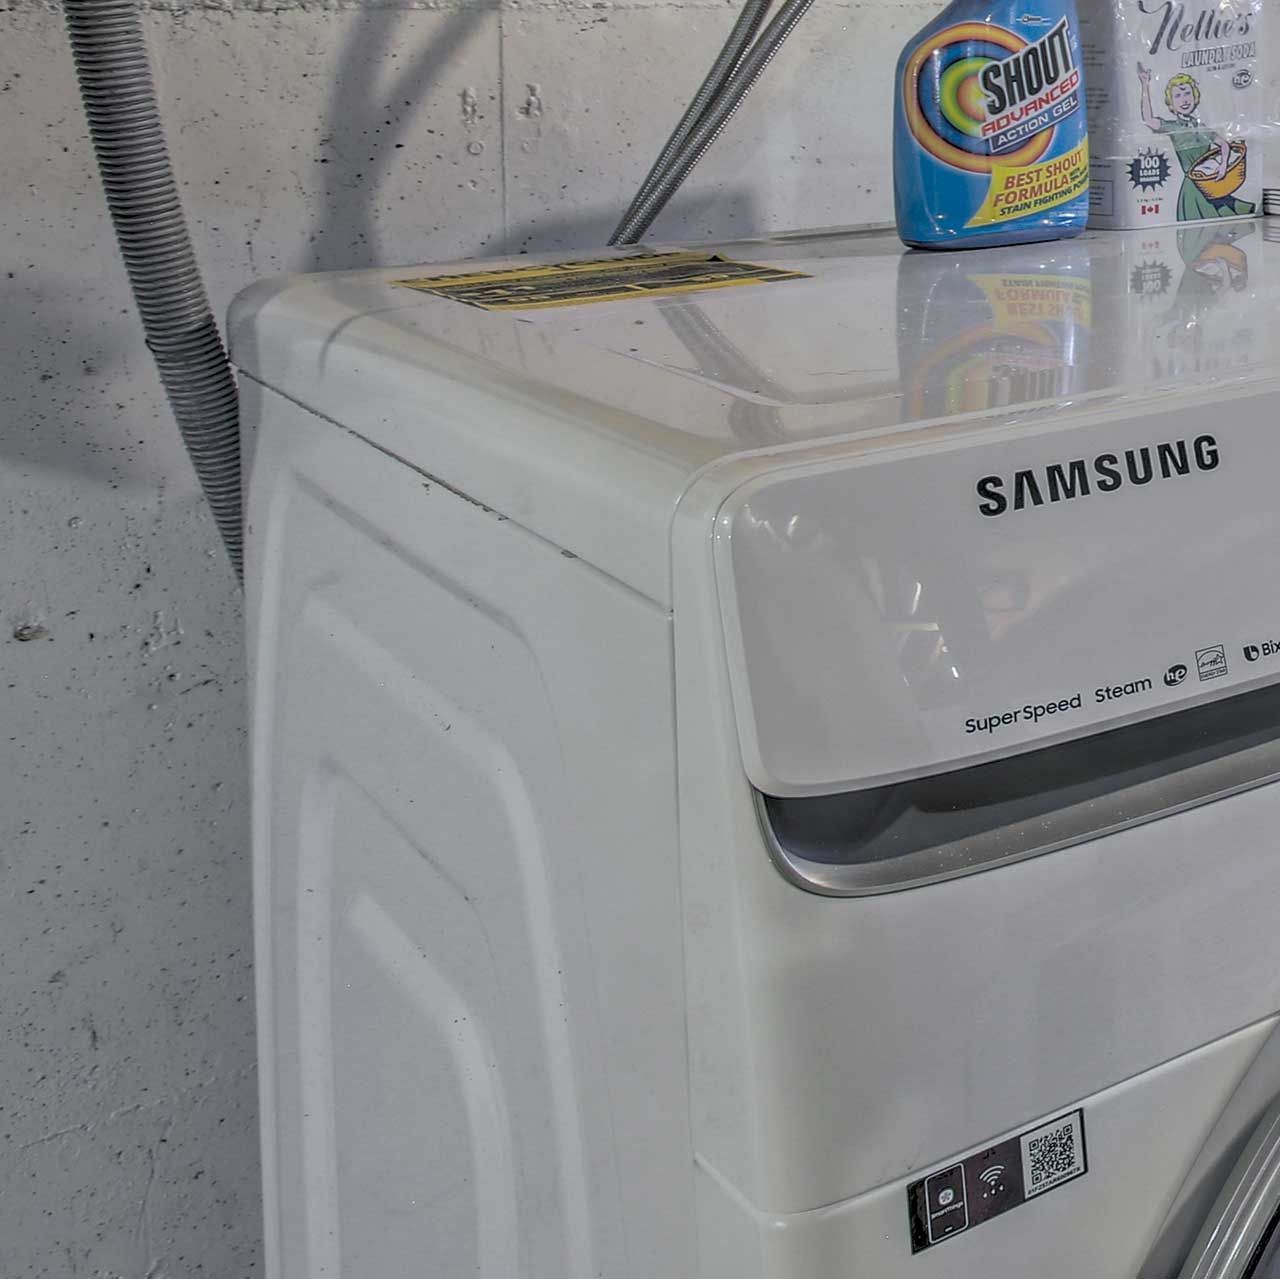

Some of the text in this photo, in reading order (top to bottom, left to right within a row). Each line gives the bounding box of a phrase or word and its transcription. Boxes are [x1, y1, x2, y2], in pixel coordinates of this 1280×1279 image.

[1138, 0, 1253, 55] Nellie's
[982, 18, 1071, 115] SHOUT
[981, 70, 1079, 136] ADVANCED
[998, 112, 1049, 146] ACTION
[1052, 97, 1078, 117] GEL
[1004, 168, 1044, 190] BEST
[1046, 150, 1082, 179] SHOUT
[1140, 157, 1160, 169] 100
[993, 174, 1069, 207] FORMULA
[1000, 201, 1032, 216] STAIN
[1033, 186, 1073, 207] FIGHTING
[976, 434, 1220, 517] SAMSUNG
[1095, 678, 1152, 703] Steam
